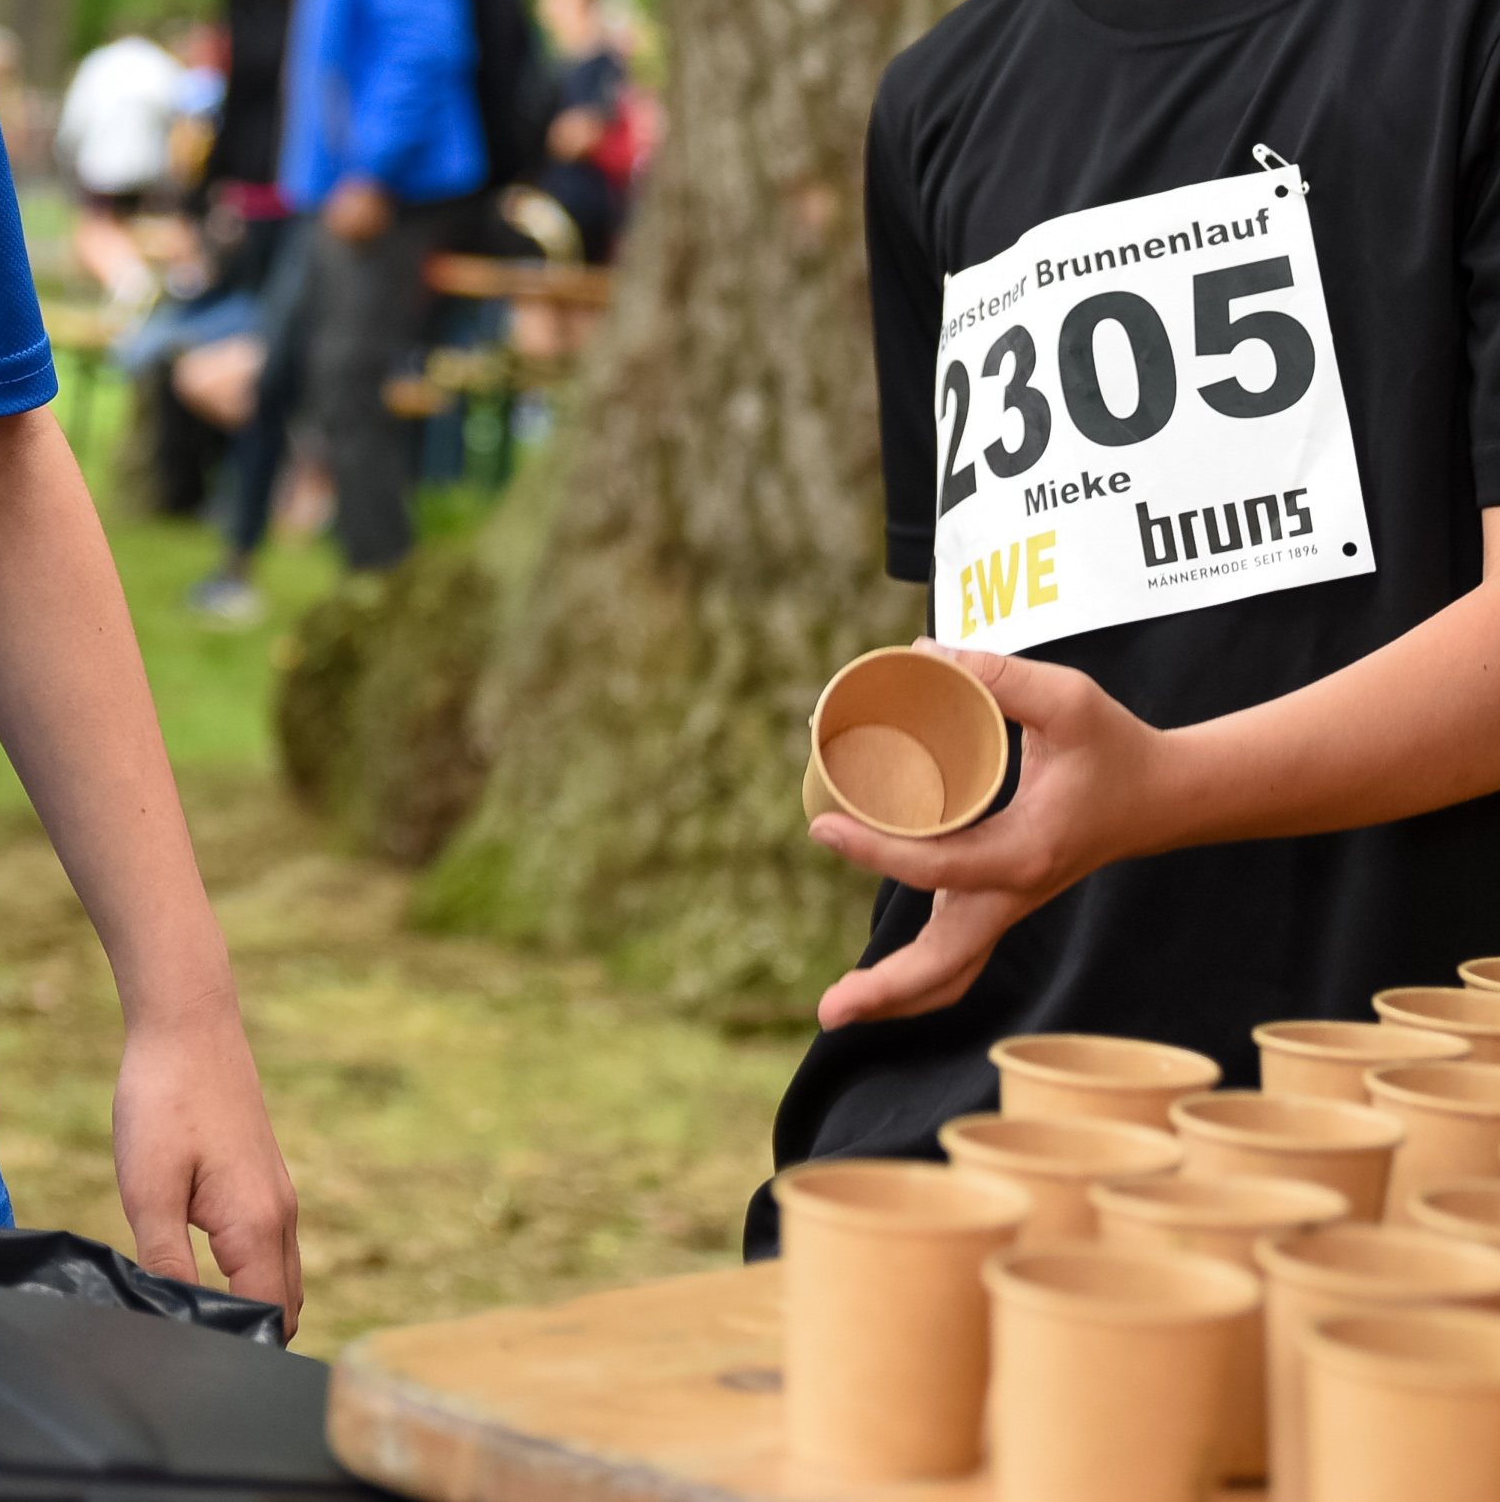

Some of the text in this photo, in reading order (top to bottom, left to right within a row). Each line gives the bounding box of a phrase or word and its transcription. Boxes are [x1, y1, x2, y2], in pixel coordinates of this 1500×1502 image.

[1036, 207, 1271, 289] Brunnenlauf
[938, 255, 1316, 520] 2305
[1024, 471, 1131, 516] Mieke
[1135, 487, 1314, 568] bruns
[960, 529, 1058, 640] EWE
[1147, 544, 1318, 590] MÄNNERMODE SEIT 1896
